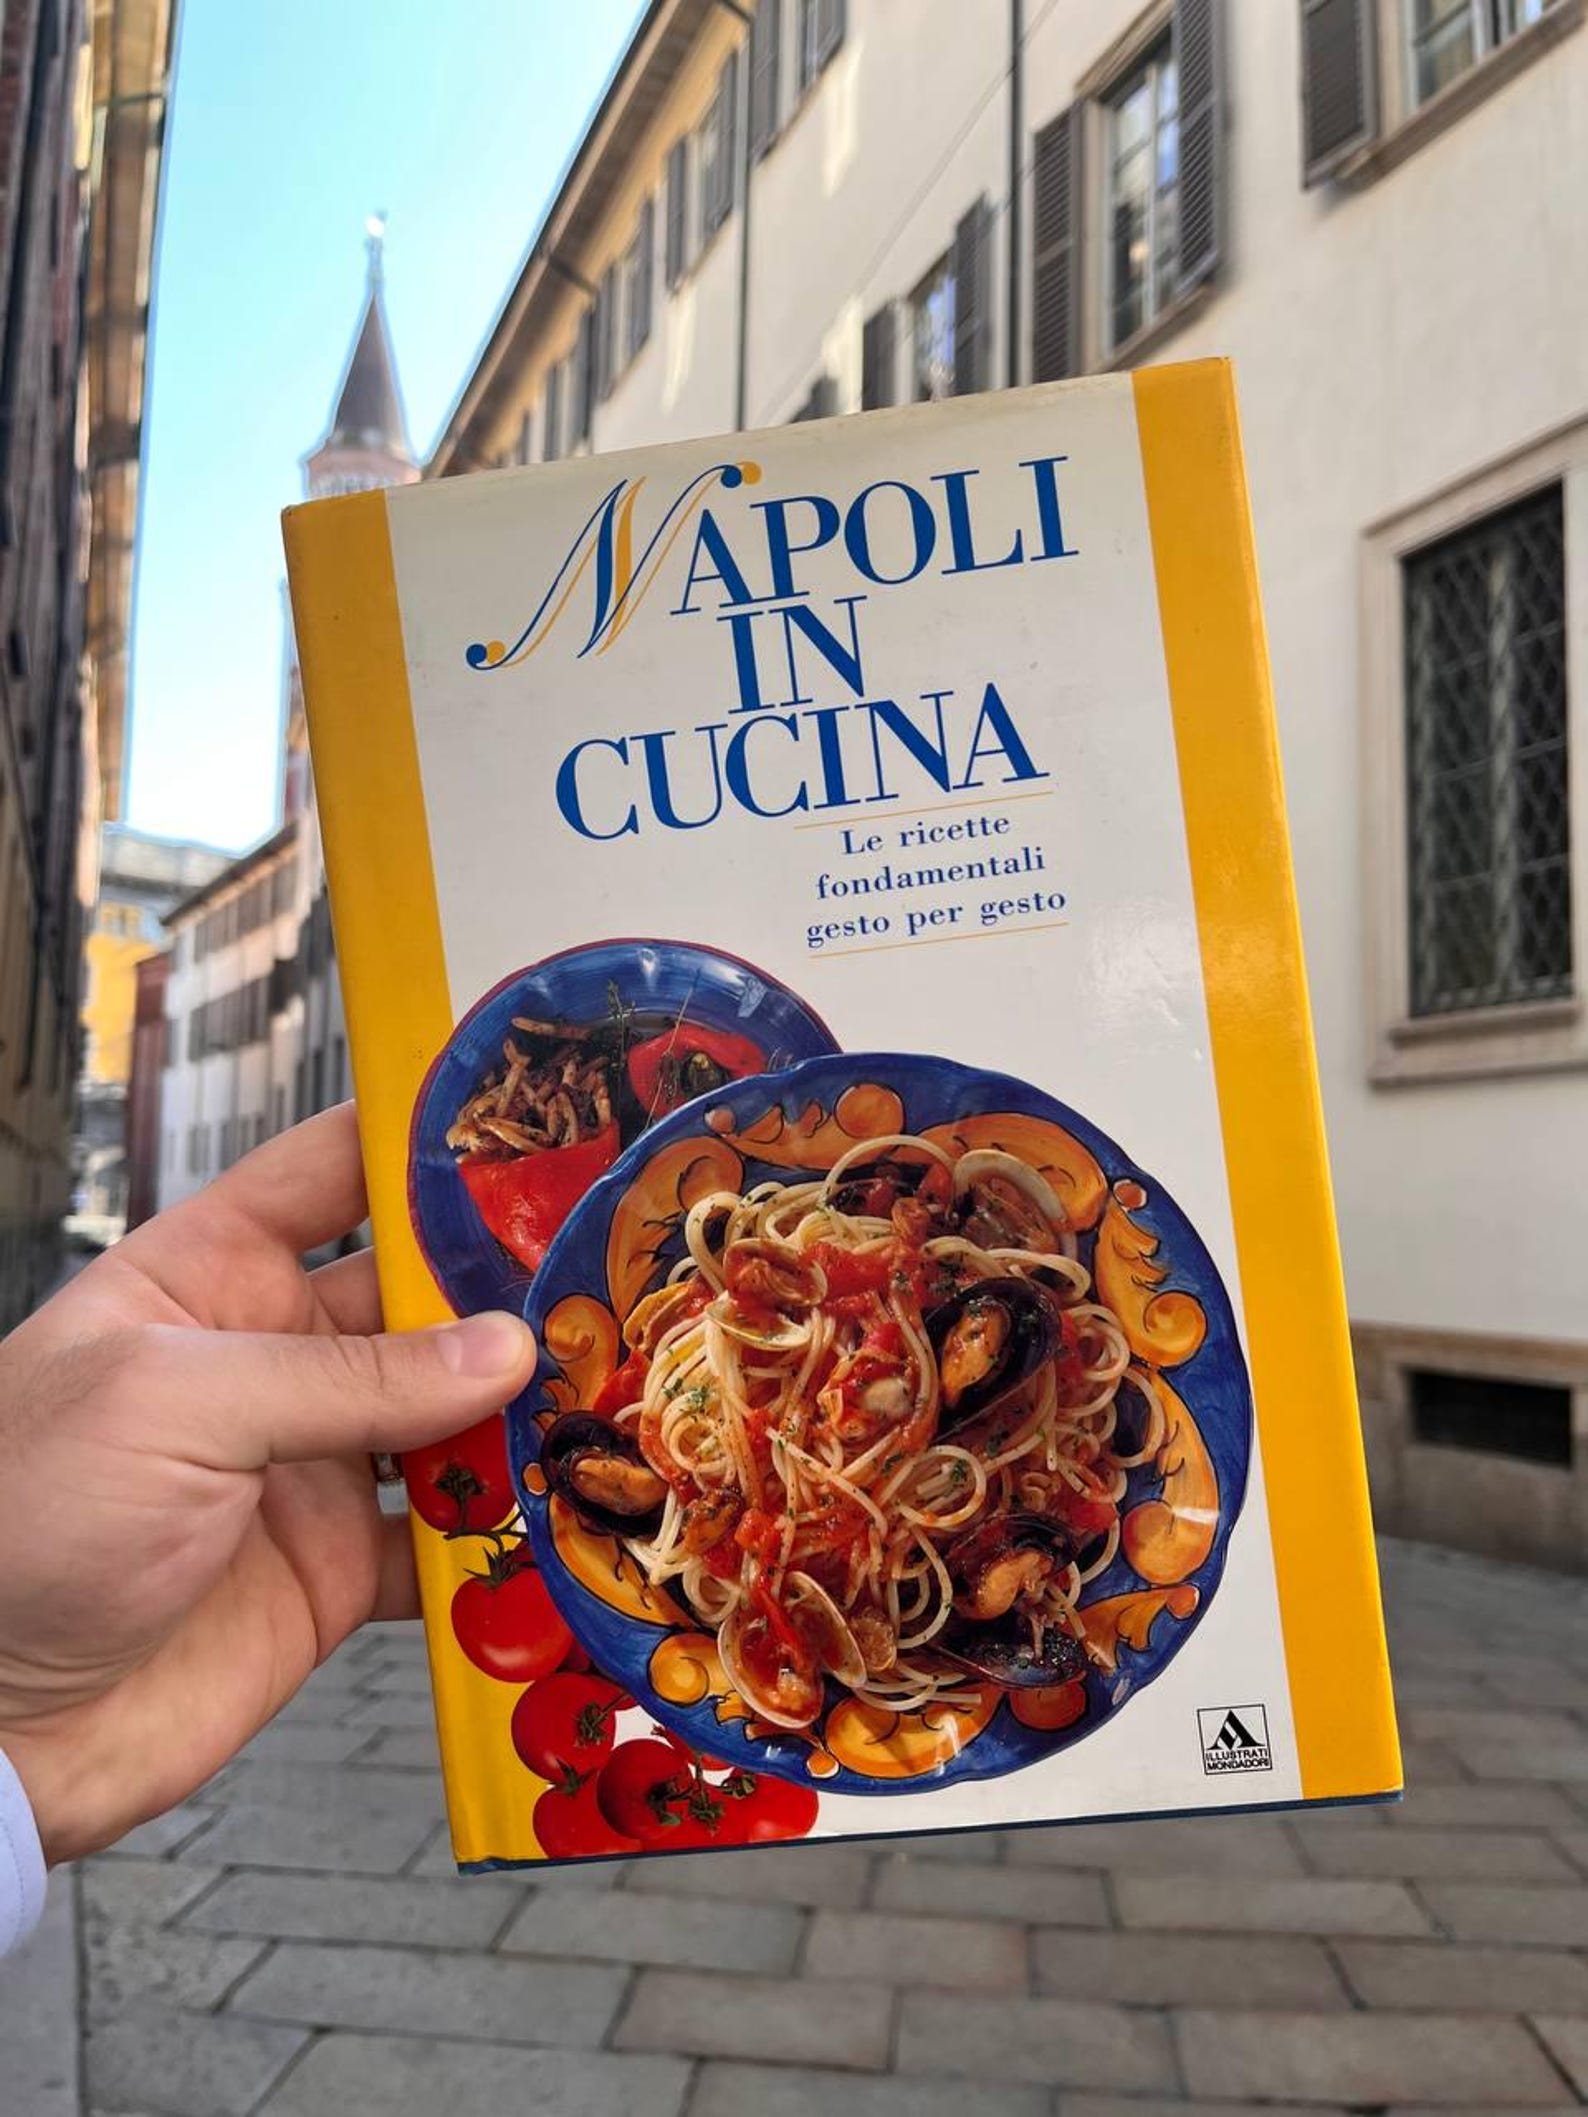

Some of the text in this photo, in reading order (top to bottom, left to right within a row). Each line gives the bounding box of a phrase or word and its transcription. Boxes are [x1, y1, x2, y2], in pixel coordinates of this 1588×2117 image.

[465, 456, 1079, 670] NAPOLI
[717, 595, 868, 714] IN
[555, 682, 1050, 841] CUCINA
[840, 816, 1010, 856] Le ricette
[816, 846, 1046, 900] fondamentali
[806, 891, 1066, 948] gesto per gesto
[1205, 1748, 1268, 1762] ILLUSTRATI
[1206, 1757, 1269, 1771] MONDADORI
